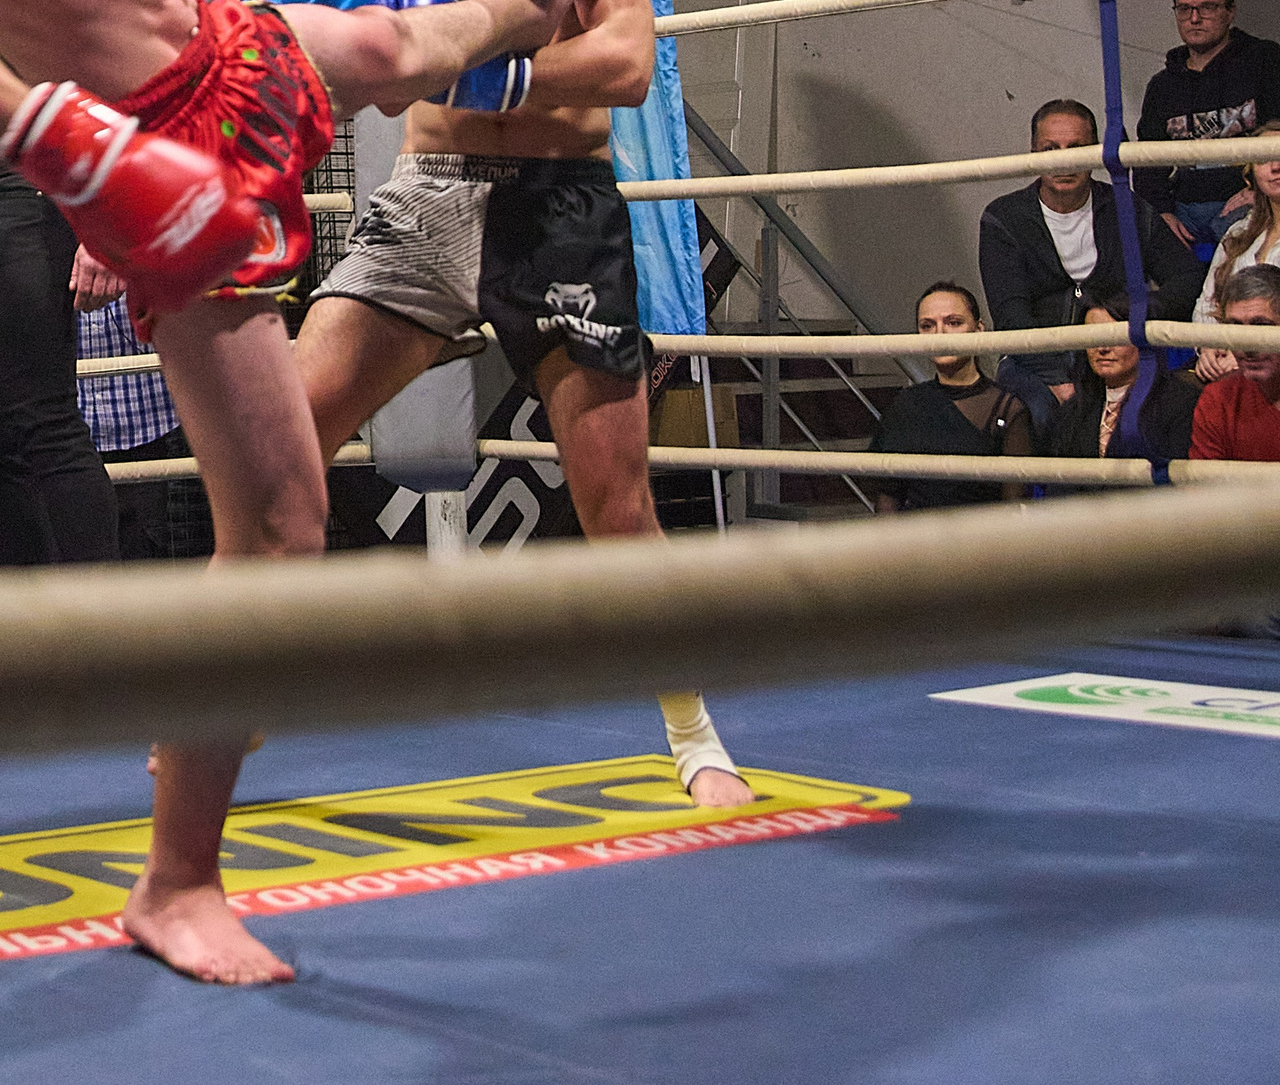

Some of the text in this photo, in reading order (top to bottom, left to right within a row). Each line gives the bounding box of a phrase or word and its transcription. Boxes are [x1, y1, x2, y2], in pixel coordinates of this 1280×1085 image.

[536, 314, 622, 347] BOXING
[227, 851, 567, 912] ГОНОЧНАЯ
[575, 807, 871, 860] КОМАНДА
